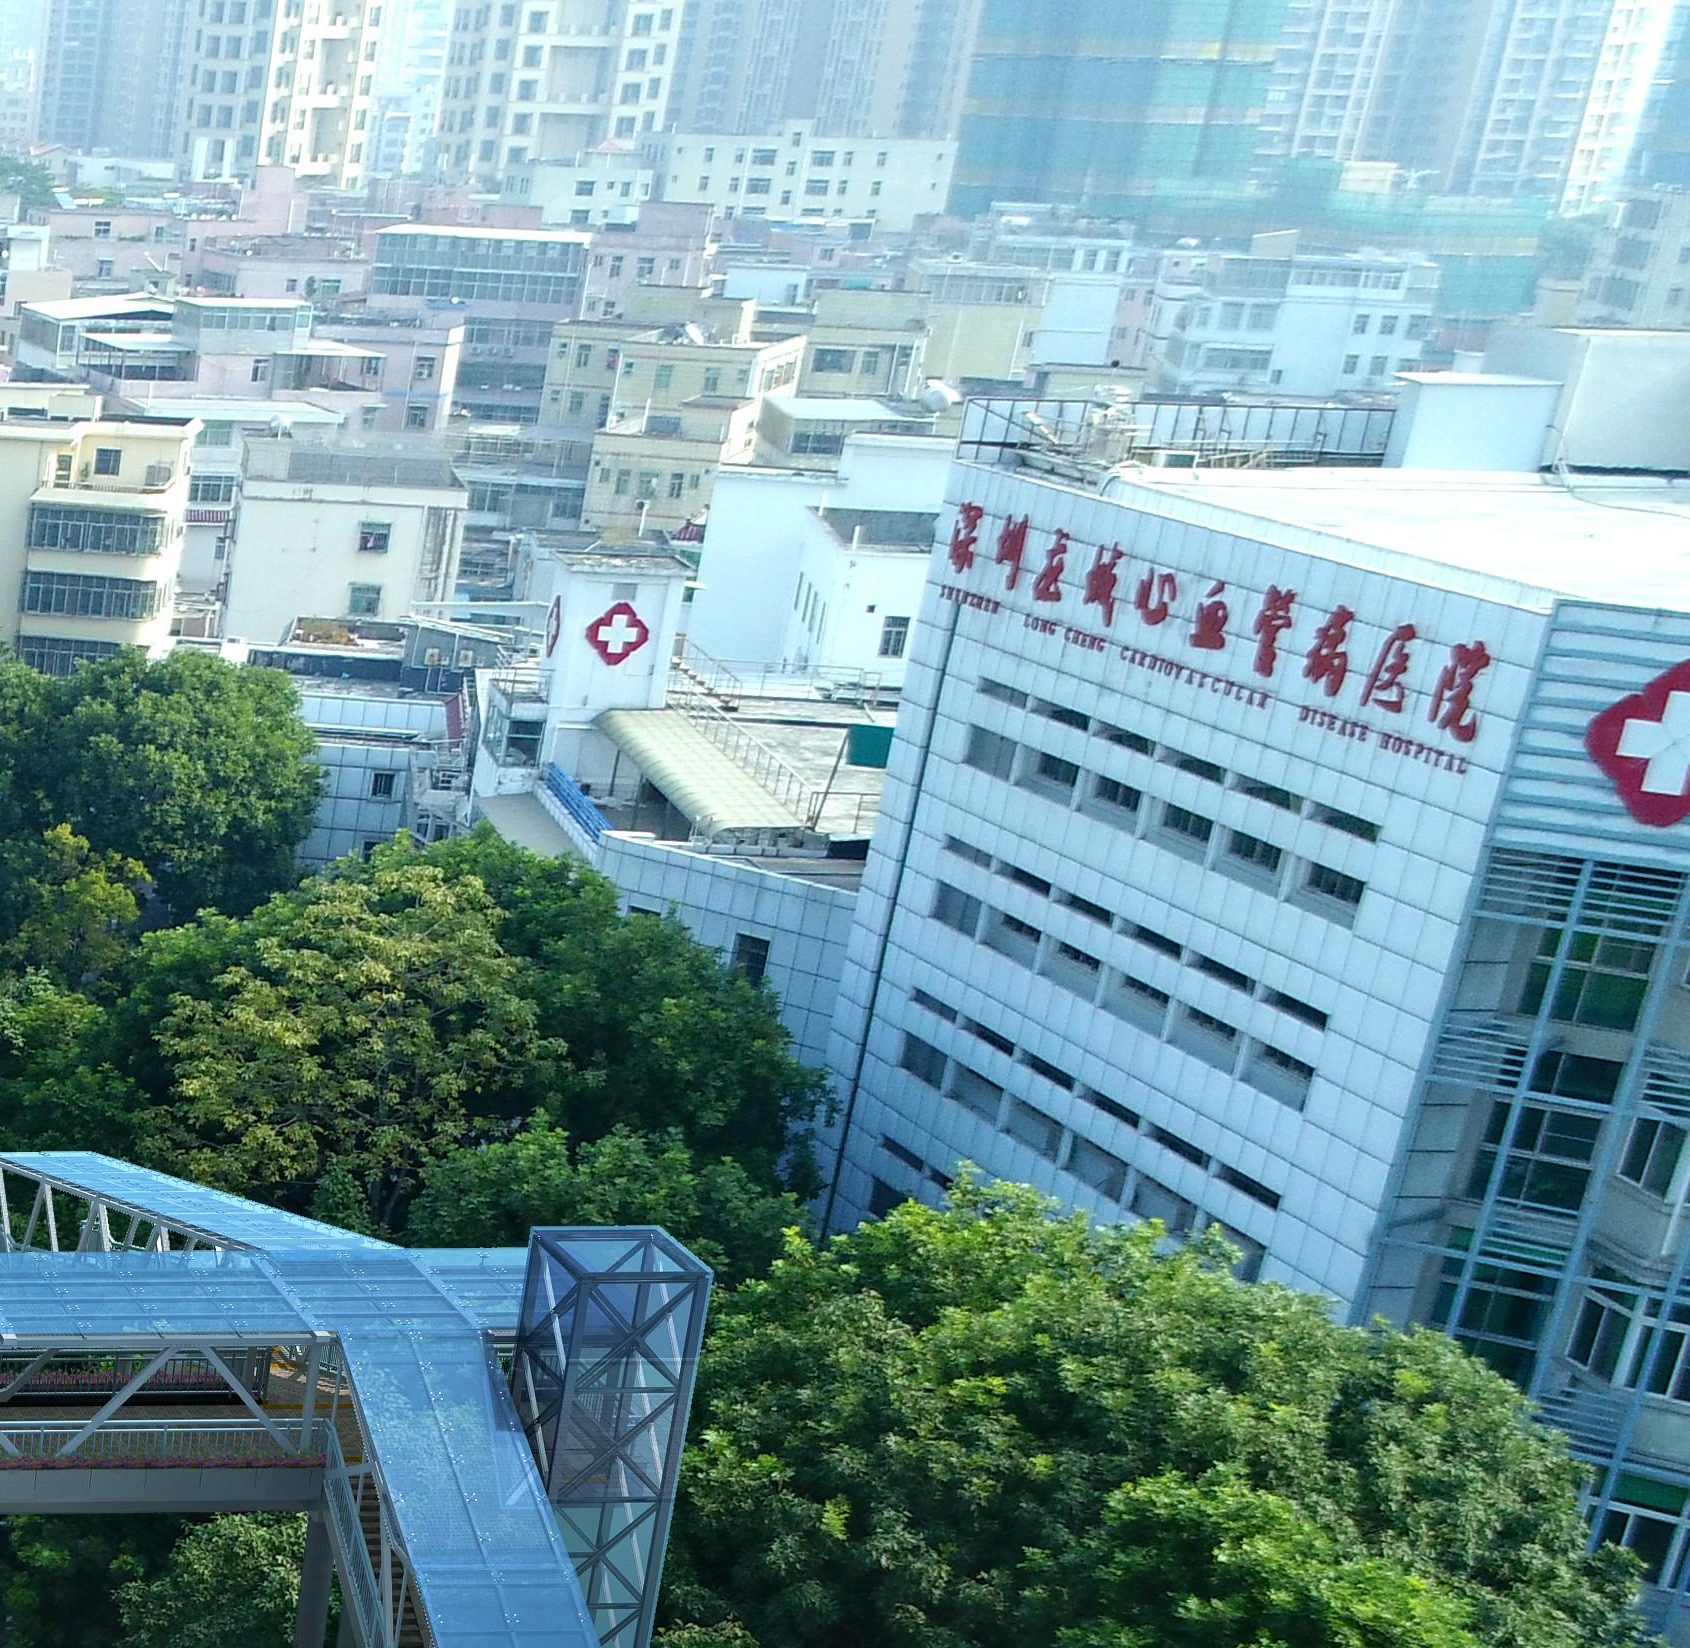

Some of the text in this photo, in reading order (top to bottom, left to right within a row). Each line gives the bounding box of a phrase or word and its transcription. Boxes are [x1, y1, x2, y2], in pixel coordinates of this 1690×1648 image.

[939, 584, 1467, 774] SHENZHEN LONG CHENG CARDIOVASCULAR DISEASE HOSPITAL
